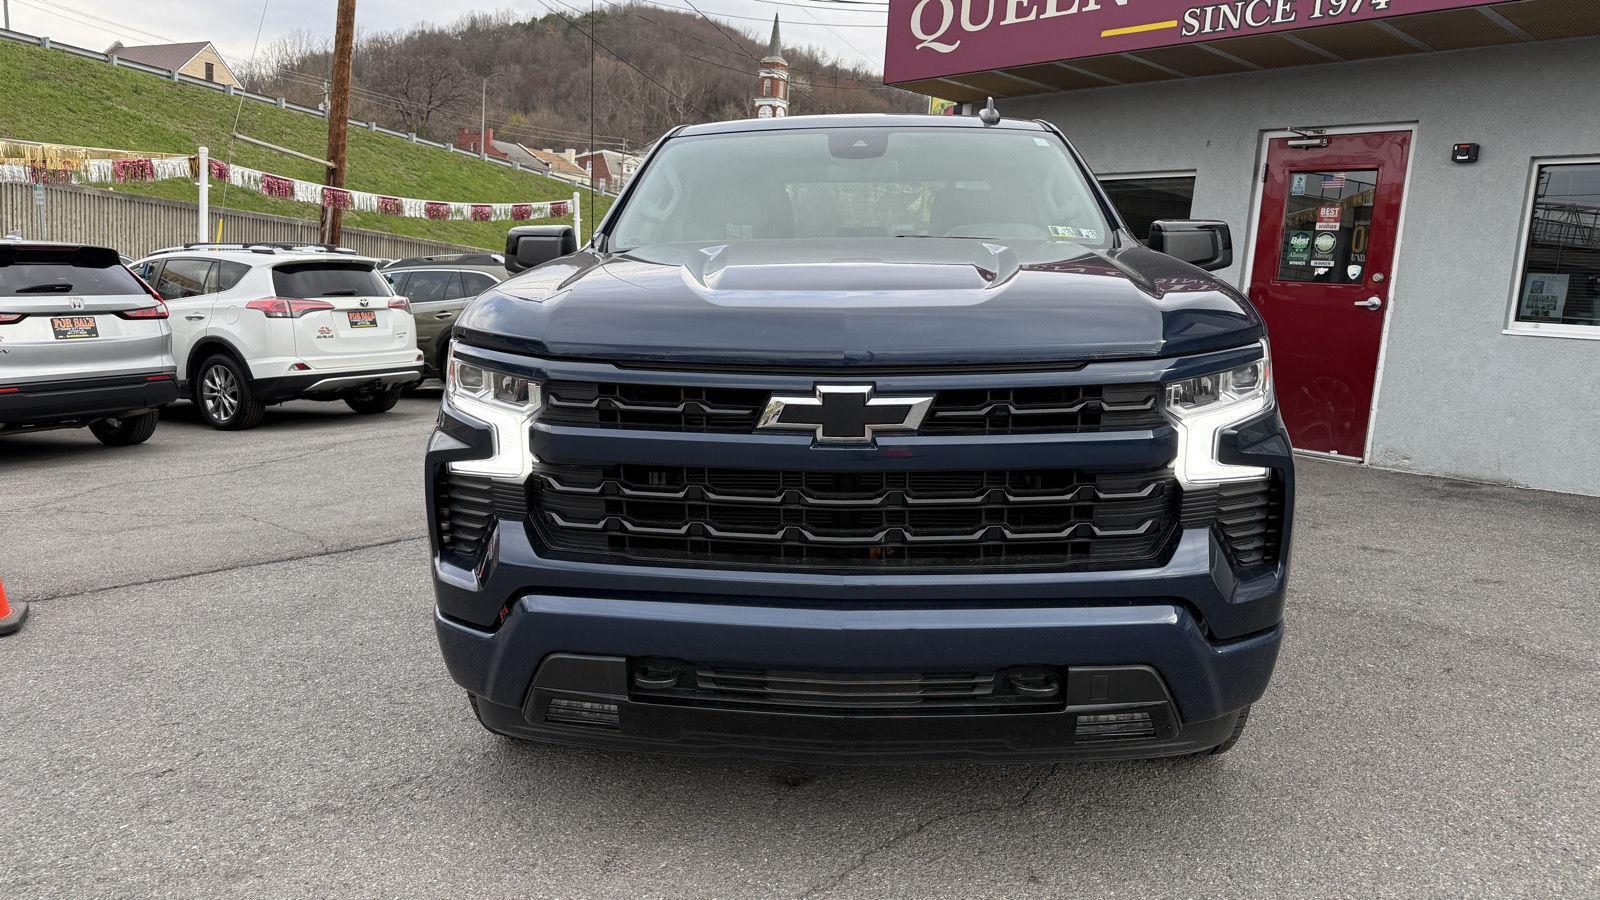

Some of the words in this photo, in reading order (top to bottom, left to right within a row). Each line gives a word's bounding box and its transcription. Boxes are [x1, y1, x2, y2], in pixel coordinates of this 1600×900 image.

[910, 0, 1129, 53] QUE
[1181, 0, 1297, 36] SINCE
[1290, 236, 1310, 244] Best
[52, 318, 72, 328] FOR
[73, 318, 95, 327] SALE
